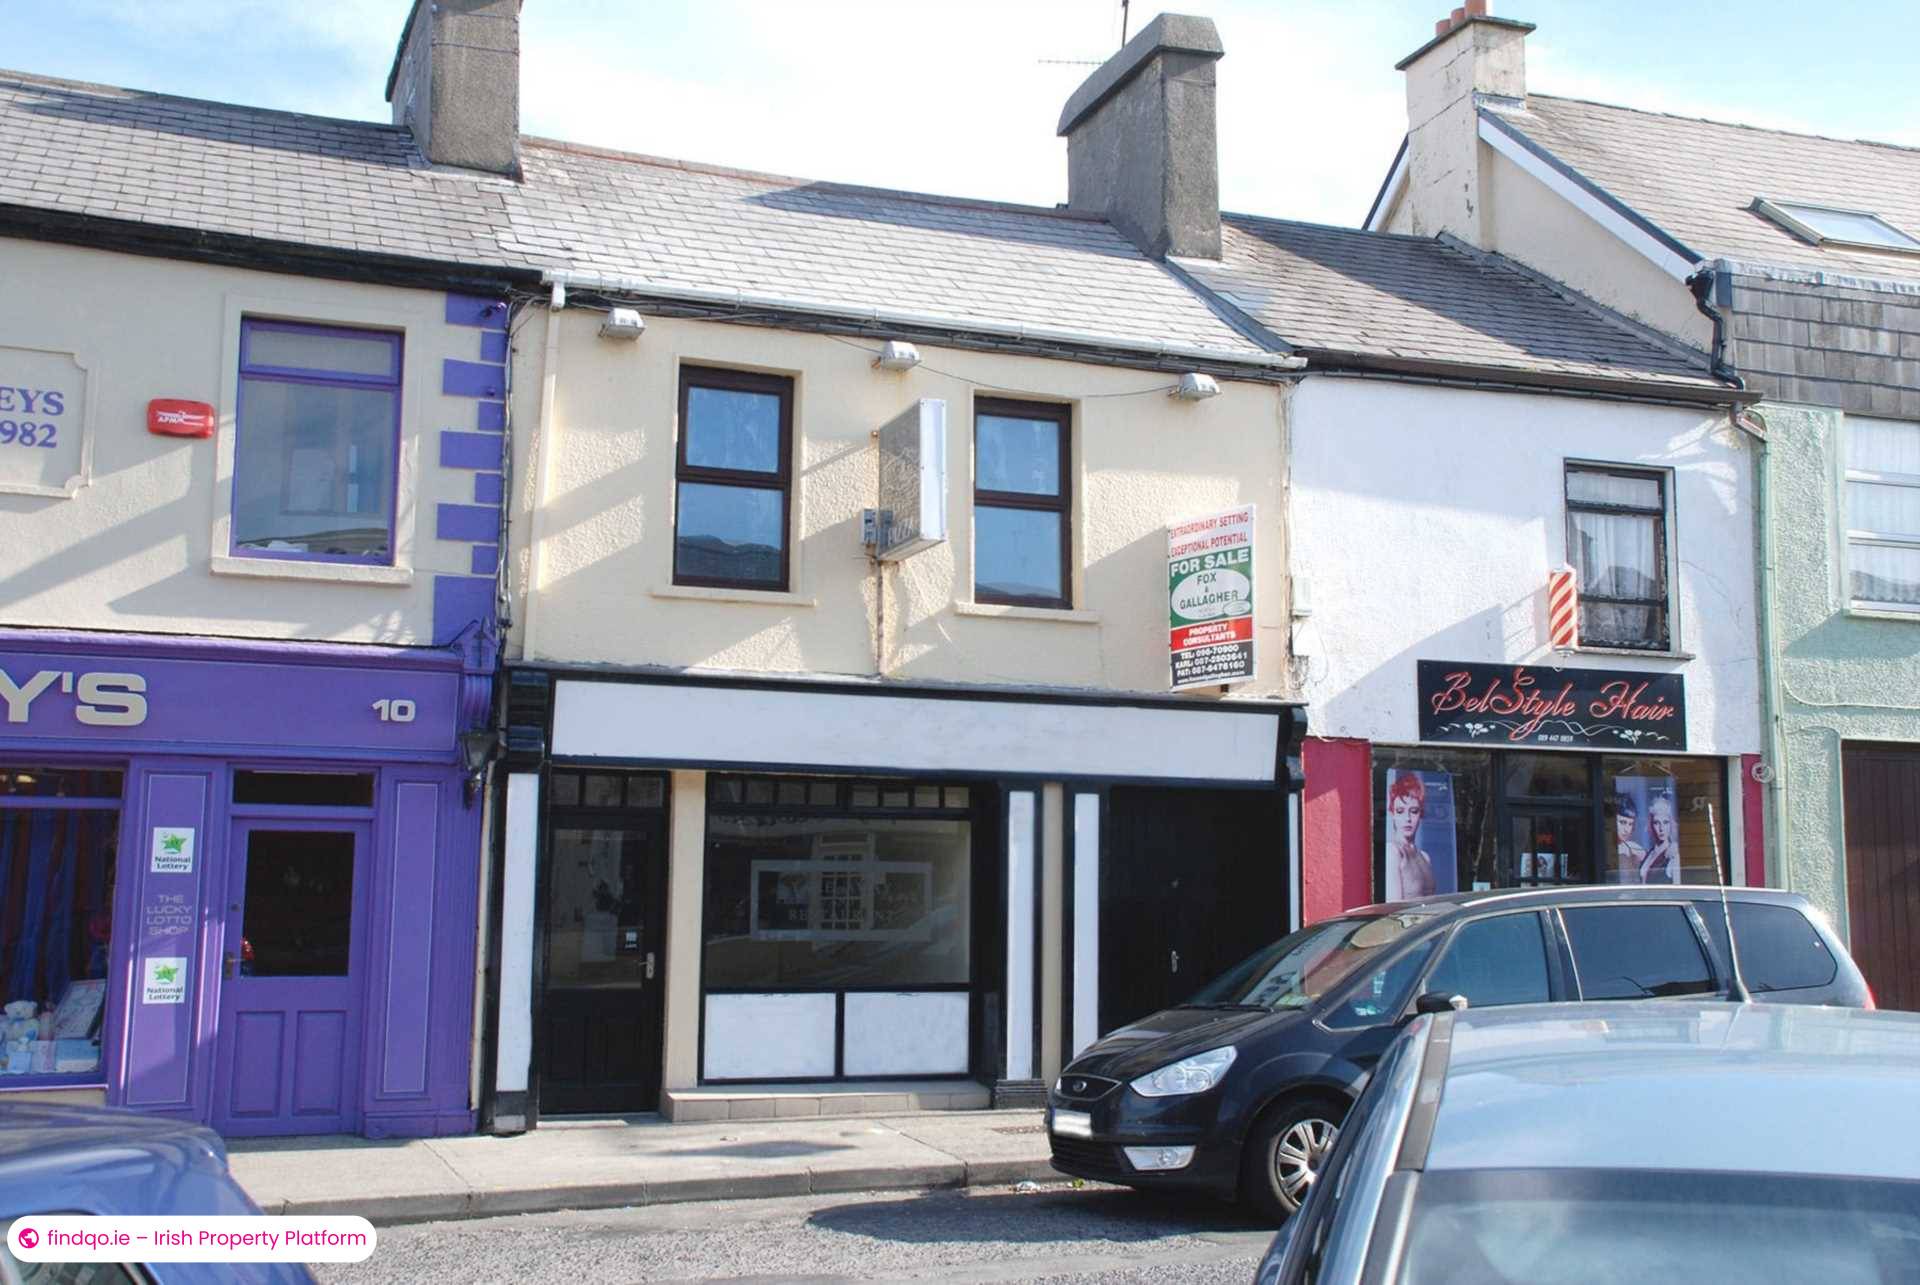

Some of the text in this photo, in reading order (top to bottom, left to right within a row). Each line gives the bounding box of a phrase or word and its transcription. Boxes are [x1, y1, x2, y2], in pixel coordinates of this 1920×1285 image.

[1219, 511, 1249, 528] SETTING
[1171, 532, 1248, 558] EXCEPTIONAL POTENTIAL
[1171, 548, 1250, 577] FOR SALE
[1196, 572, 1217, 585] FOX
[1179, 590, 1238, 610] GALLAGHER
[1188, 622, 1229, 637] PROPERTY
[1182, 631, 1237, 647] CONSULTANTS
[0, 669, 148, 727] Y'S
[1588, 680, 1675, 721] Hair
[371, 698, 416, 722] 10
[154, 855, 191, 864] National
[156, 862, 188, 870] Lottery
[158, 894, 185, 904] THE
[146, 905, 192, 914] LUCKY
[146, 915, 192, 925] LOTTO
[148, 925, 189, 936] SHOP
[146, 986, 184, 995] National
[148, 993, 181, 1002] Lottery
